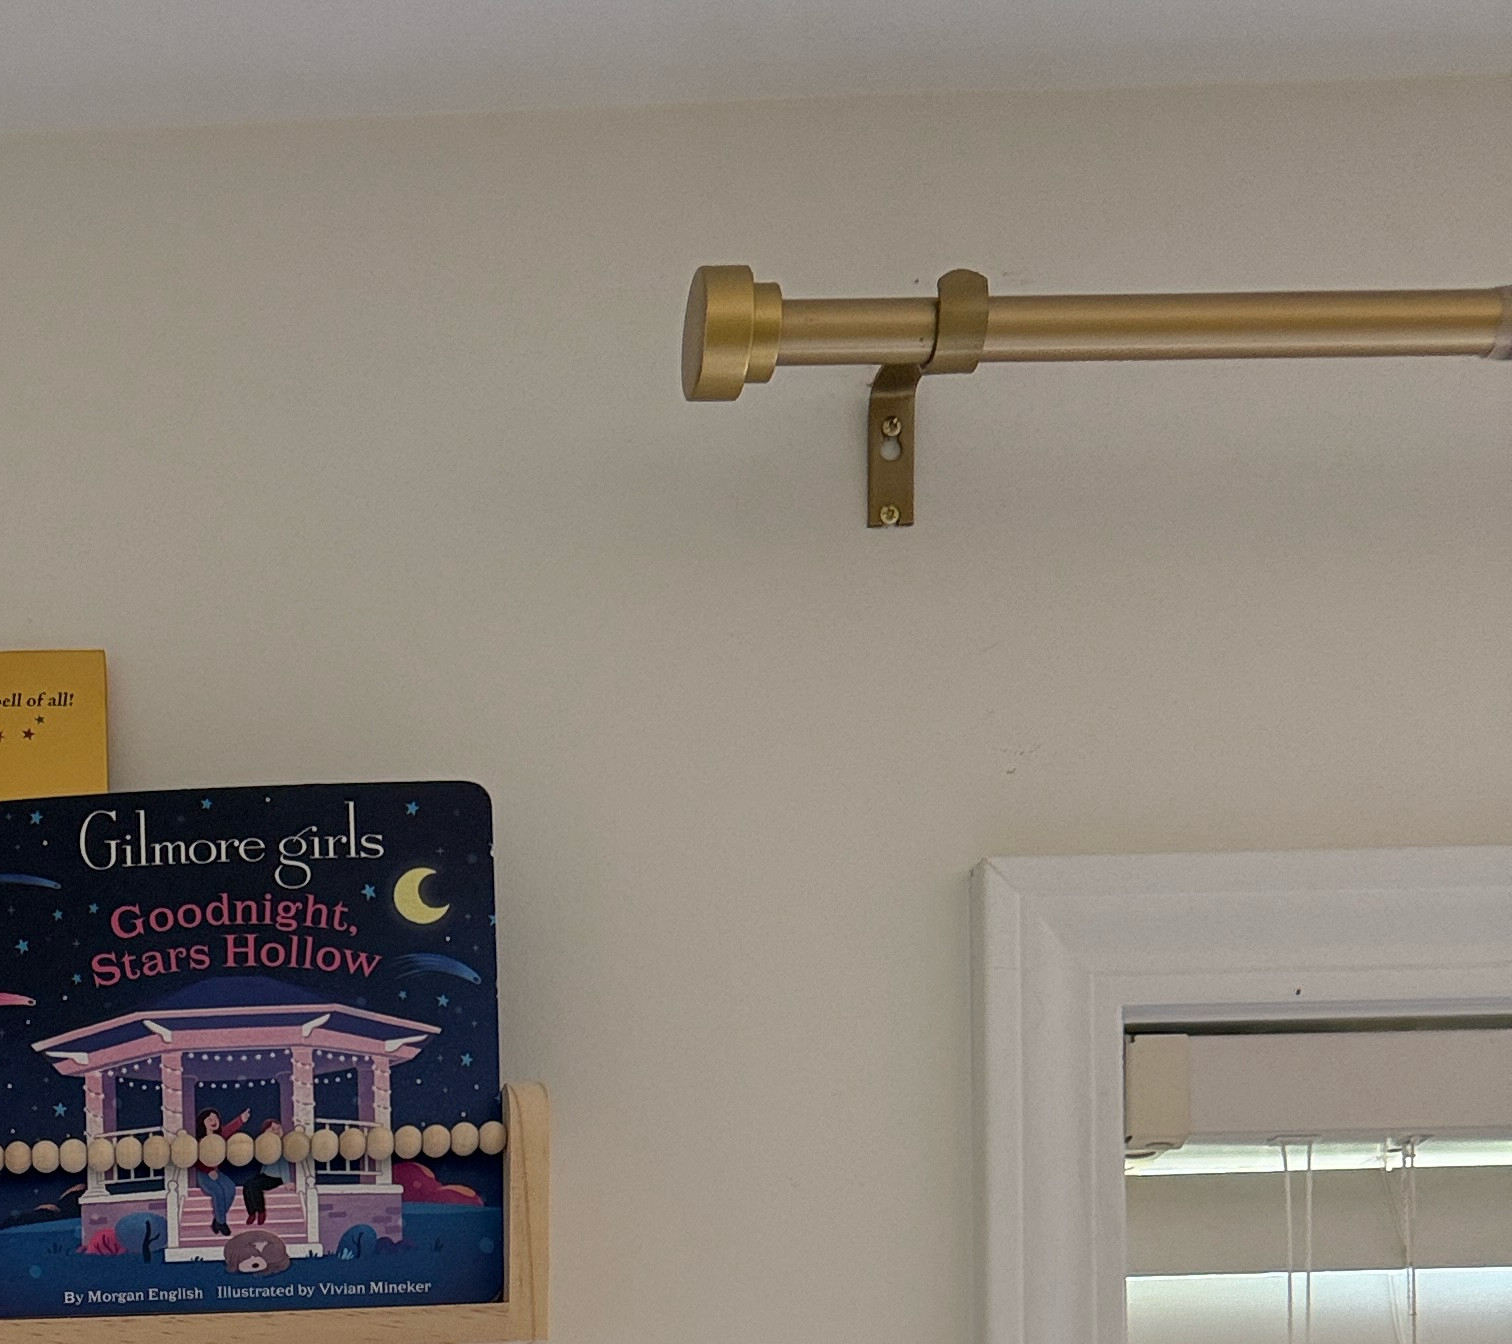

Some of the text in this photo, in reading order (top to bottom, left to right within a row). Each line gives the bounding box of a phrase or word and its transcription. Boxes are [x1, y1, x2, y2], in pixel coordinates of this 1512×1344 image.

[26, 692, 45, 709] of
[48, 691, 75, 708] all!
[79, 800, 385, 890] Gilmore girls
[110, 892, 359, 940] Goodnight,
[90, 933, 383, 989] Stars Hollow
[63, 1286, 204, 1307] By Morgan English
[216, 1280, 432, 1300] Illustrated by Vivian Mineker
